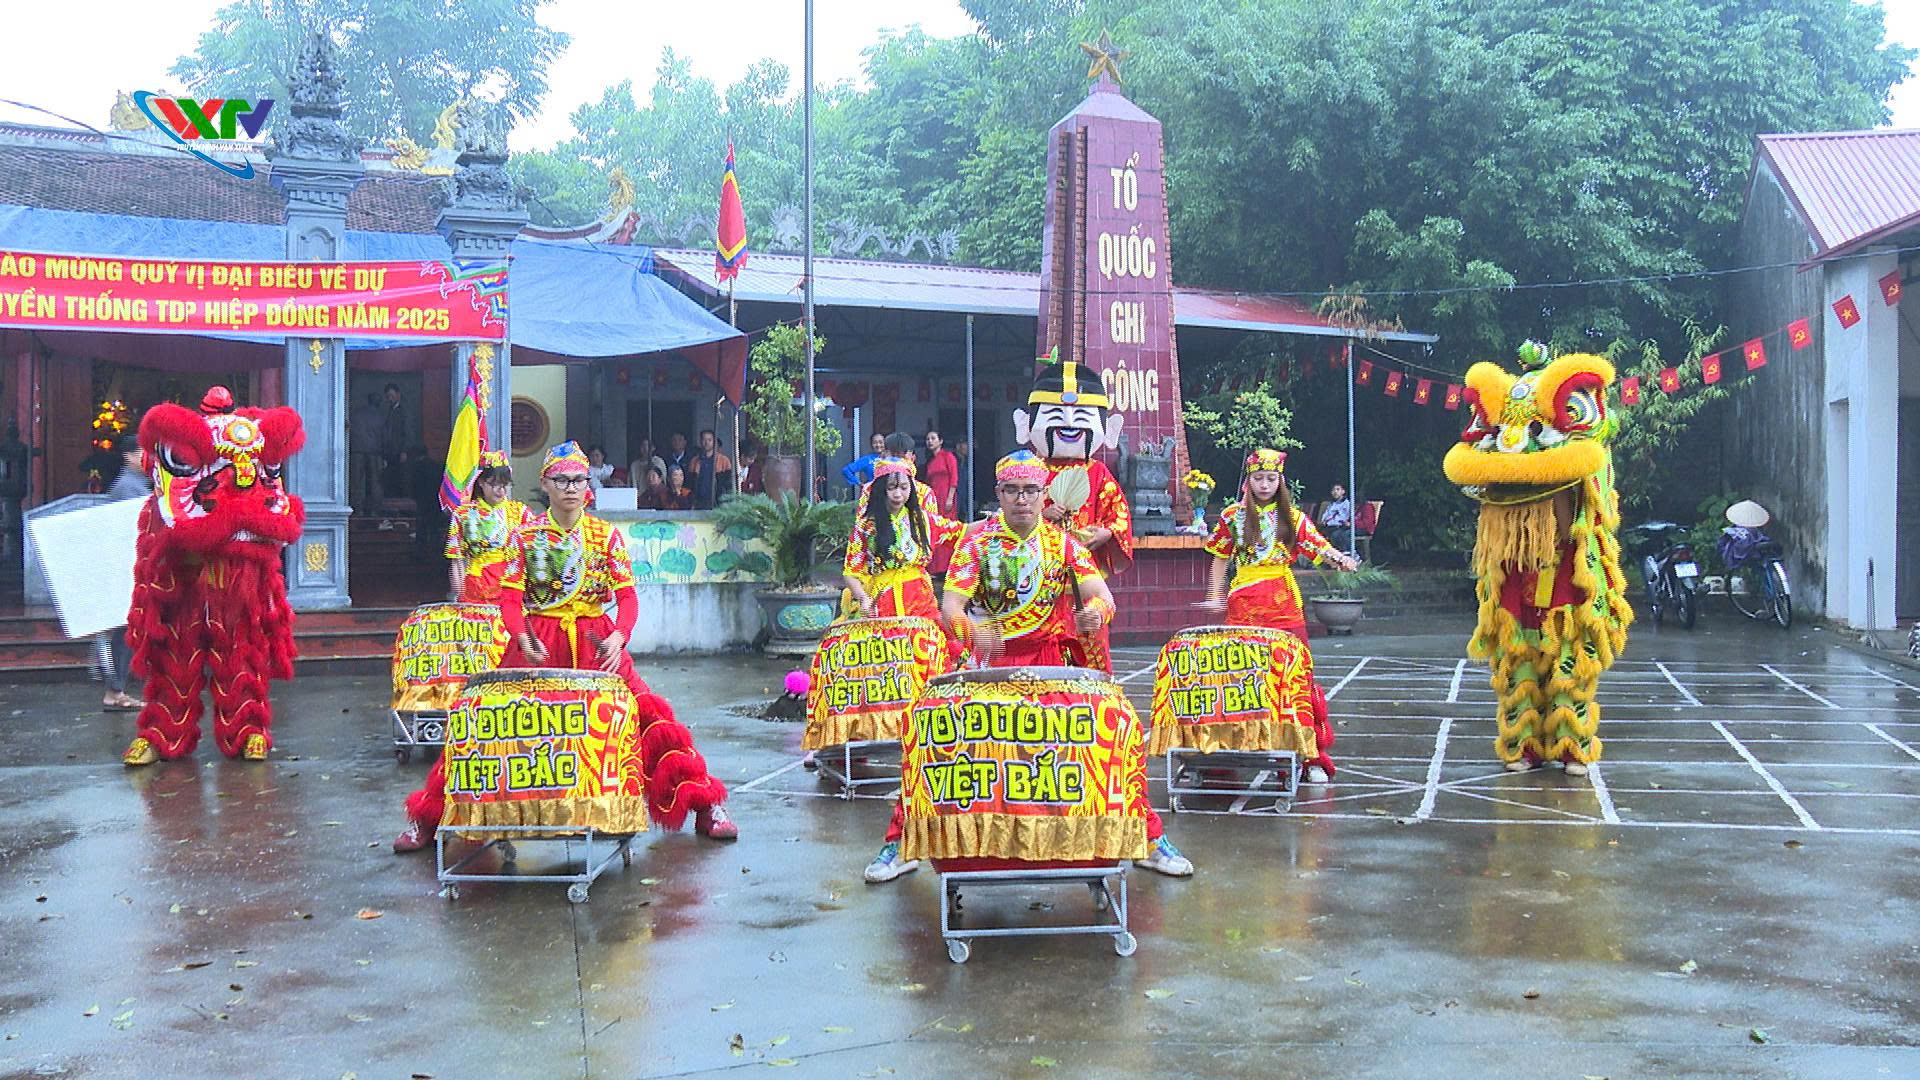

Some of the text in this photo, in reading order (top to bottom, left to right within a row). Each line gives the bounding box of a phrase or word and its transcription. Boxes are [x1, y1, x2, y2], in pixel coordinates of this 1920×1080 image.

[1110, 151, 1140, 212] TỔ
[1098, 223, 1157, 280] QUỐC
[44, 256, 123, 281] MỪNG
[130, 260, 180, 286] QUÝ
[185, 264, 206, 290] VỊ
[211, 265, 253, 291] ĐẠI
[259, 264, 314, 289] BIỂU
[319, 263, 348, 290] VỀ
[354, 267, 388, 296] DỰ
[0, 286, 451, 331] YỀN THỐNG TDP HIỆP ĐỒNG NĂM 2025
[1110, 301, 1145, 344] GHI
[1101, 359, 1160, 412] CÔNG
[476, 698, 587, 742] ĐƯỜNG
[1170, 683, 1218, 721] VIỆT
[507, 742, 578, 791] BẮC
[923, 749, 1084, 810] VIỆT BẮC
